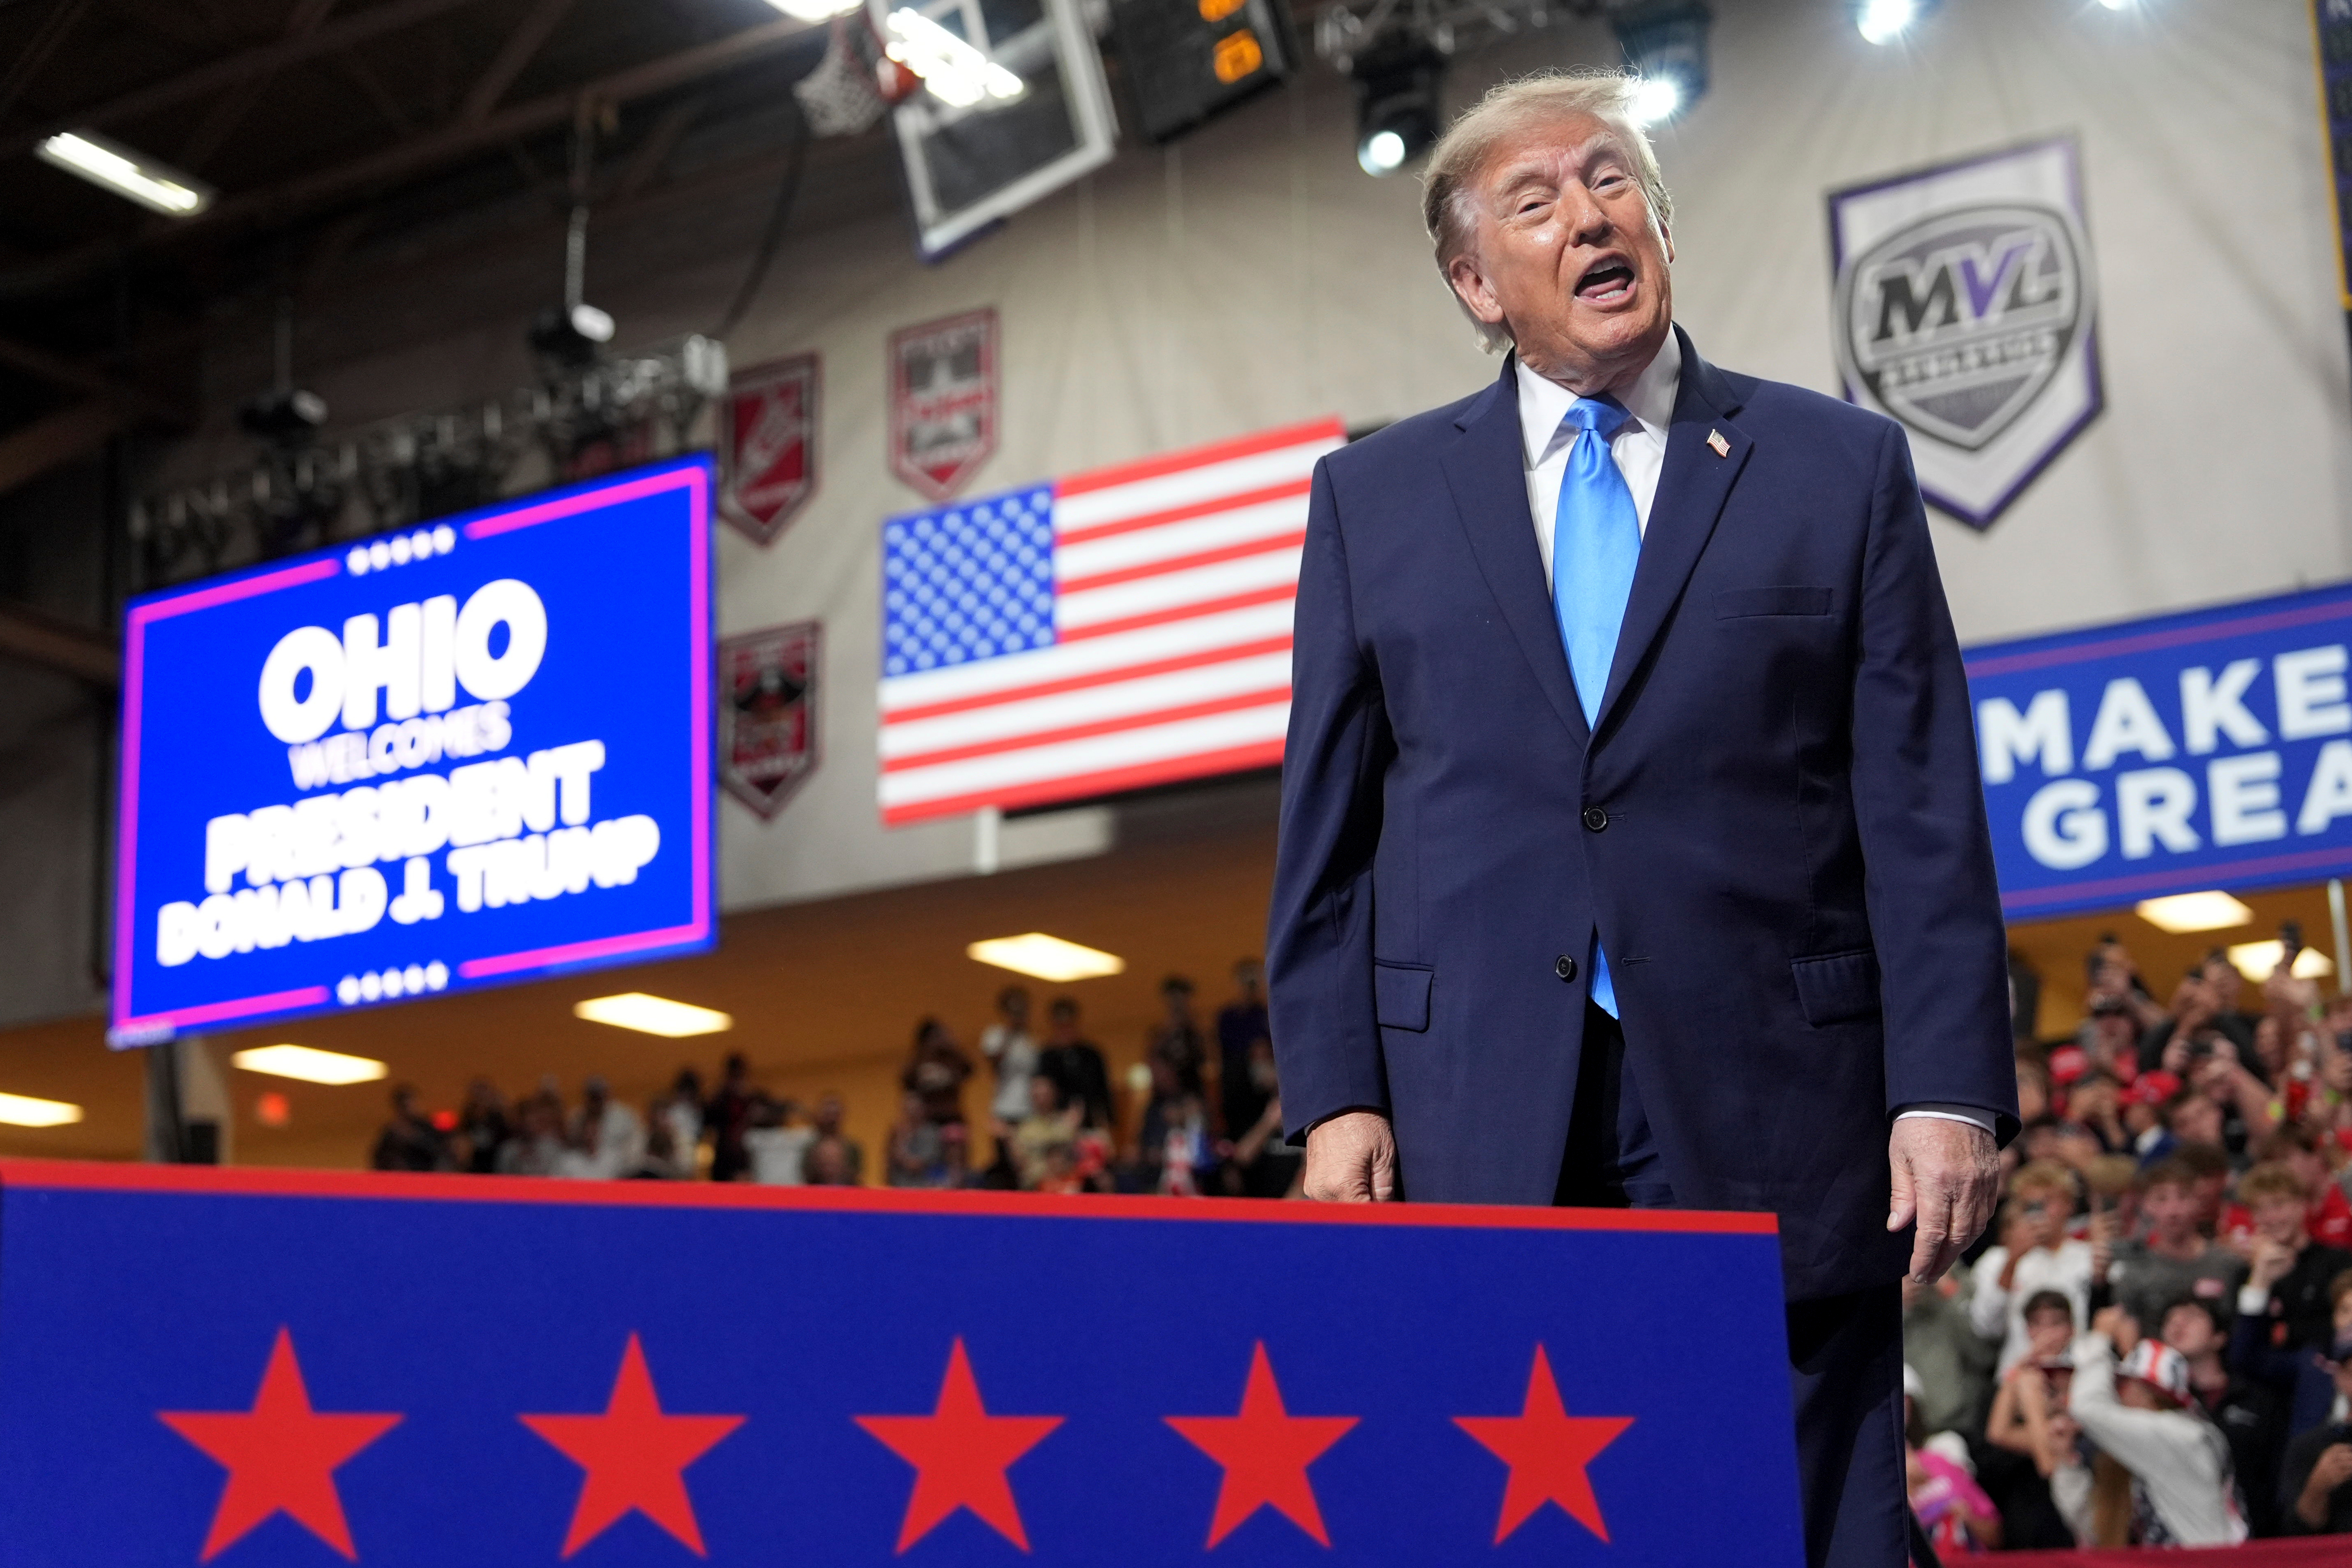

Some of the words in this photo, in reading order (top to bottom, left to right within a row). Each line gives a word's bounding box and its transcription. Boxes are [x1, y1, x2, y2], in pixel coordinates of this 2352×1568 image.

[1871, 241, 2062, 342] MVL
[260, 579, 547, 743] OHIO
[1978, 644, 2352, 784] MAKE
[206, 739, 605, 894] PRESIDENT
[288, 700, 511, 790] WELCOMES
[156, 866, 387, 966] DONALD
[389, 856, 444, 924] J.
[447, 815, 660, 912] TRUMP
